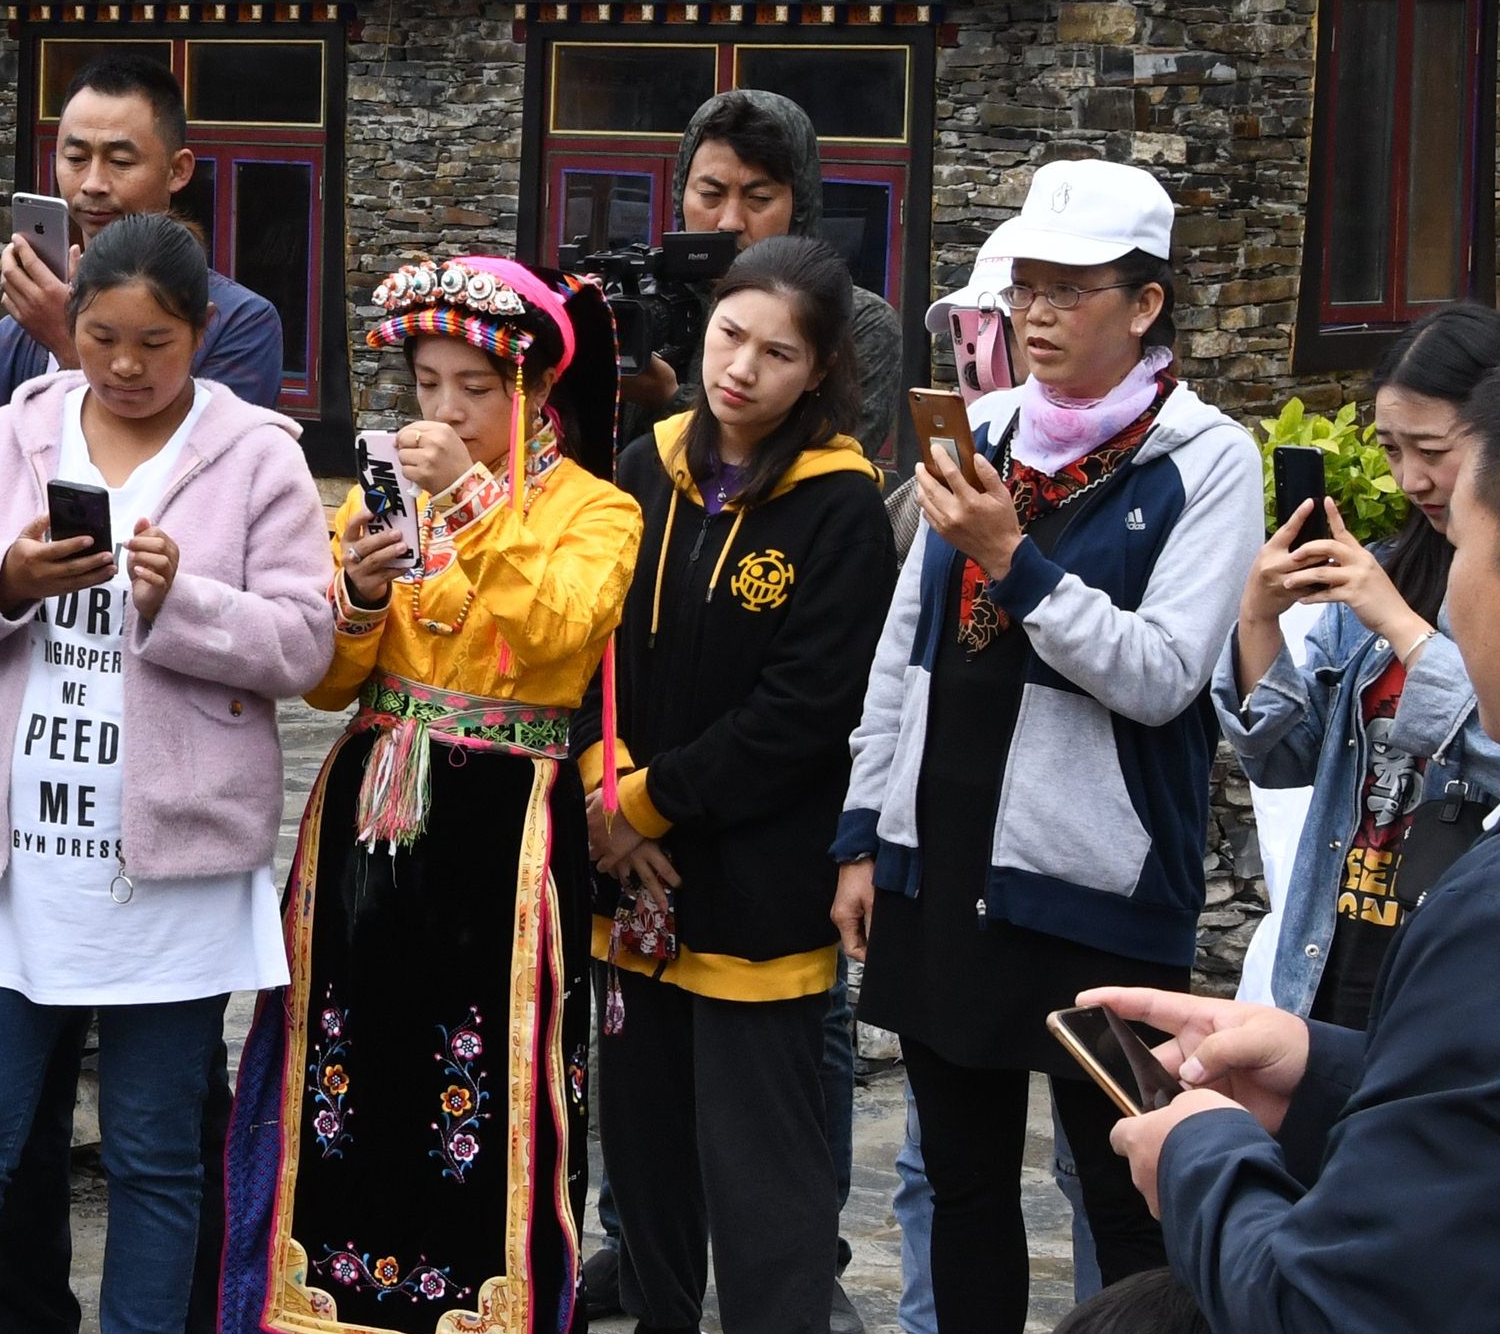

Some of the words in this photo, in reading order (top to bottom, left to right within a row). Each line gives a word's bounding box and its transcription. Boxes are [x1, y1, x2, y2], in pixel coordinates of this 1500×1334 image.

[62, 681, 87, 706] ME
[24, 713, 120, 765] PEED
[39, 780, 96, 828] ME
